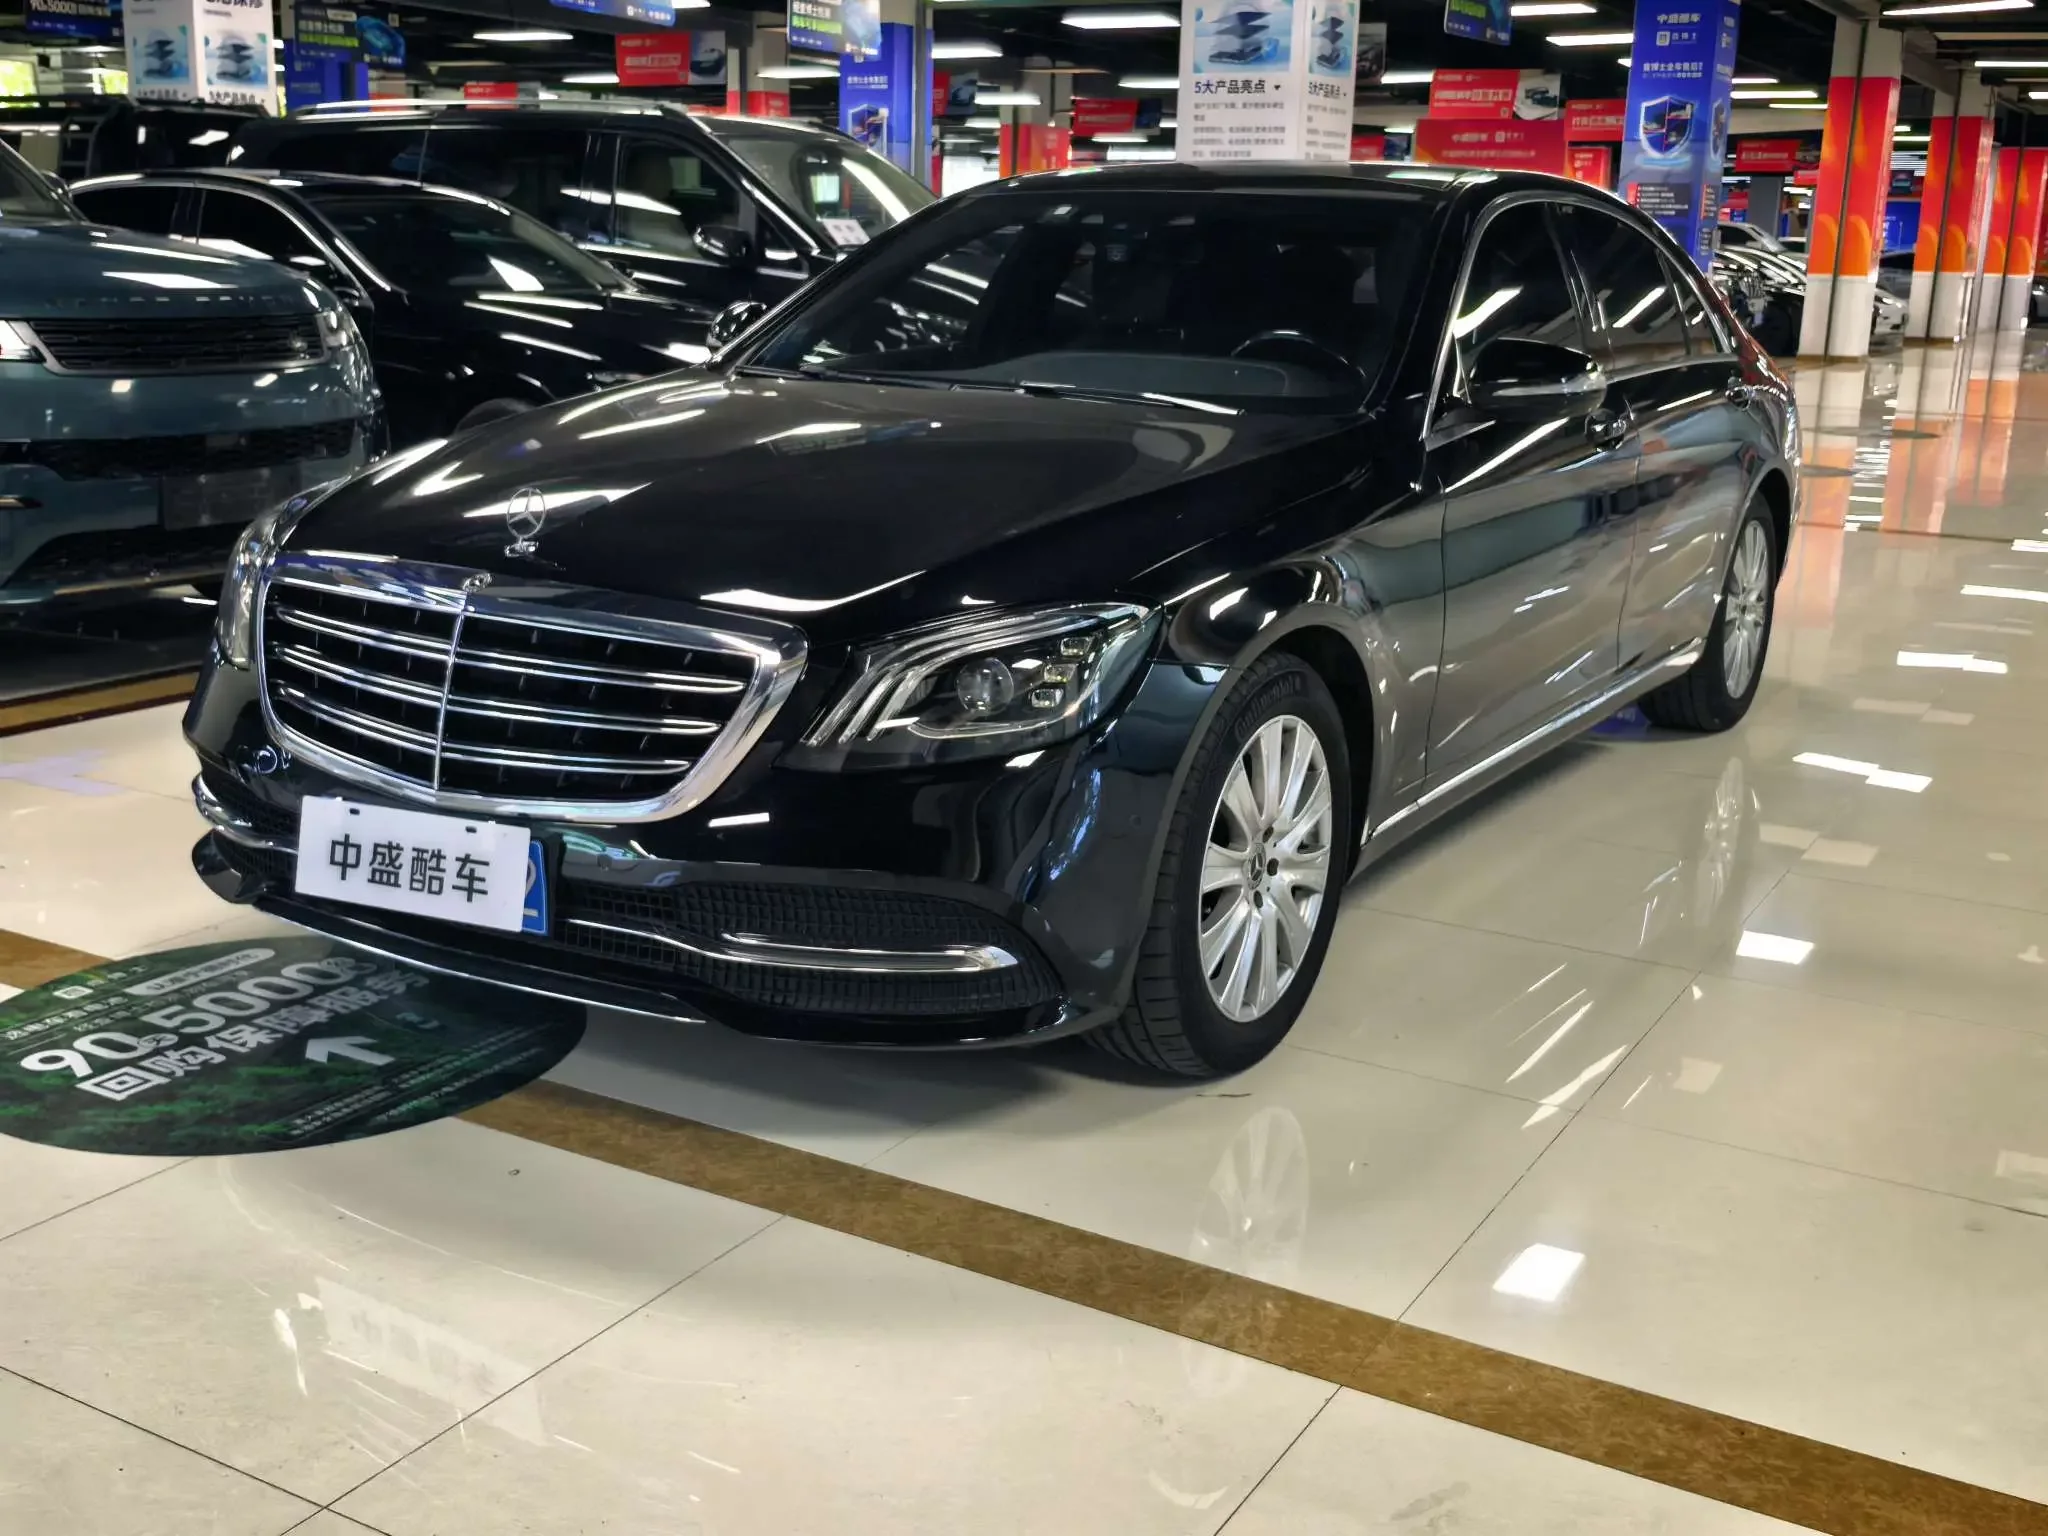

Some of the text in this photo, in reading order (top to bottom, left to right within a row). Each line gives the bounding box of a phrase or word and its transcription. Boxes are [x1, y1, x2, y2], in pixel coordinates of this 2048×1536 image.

[1194, 80, 1266, 94] 5大产品亮点
[329, 833, 490, 903] 中盛酷车
